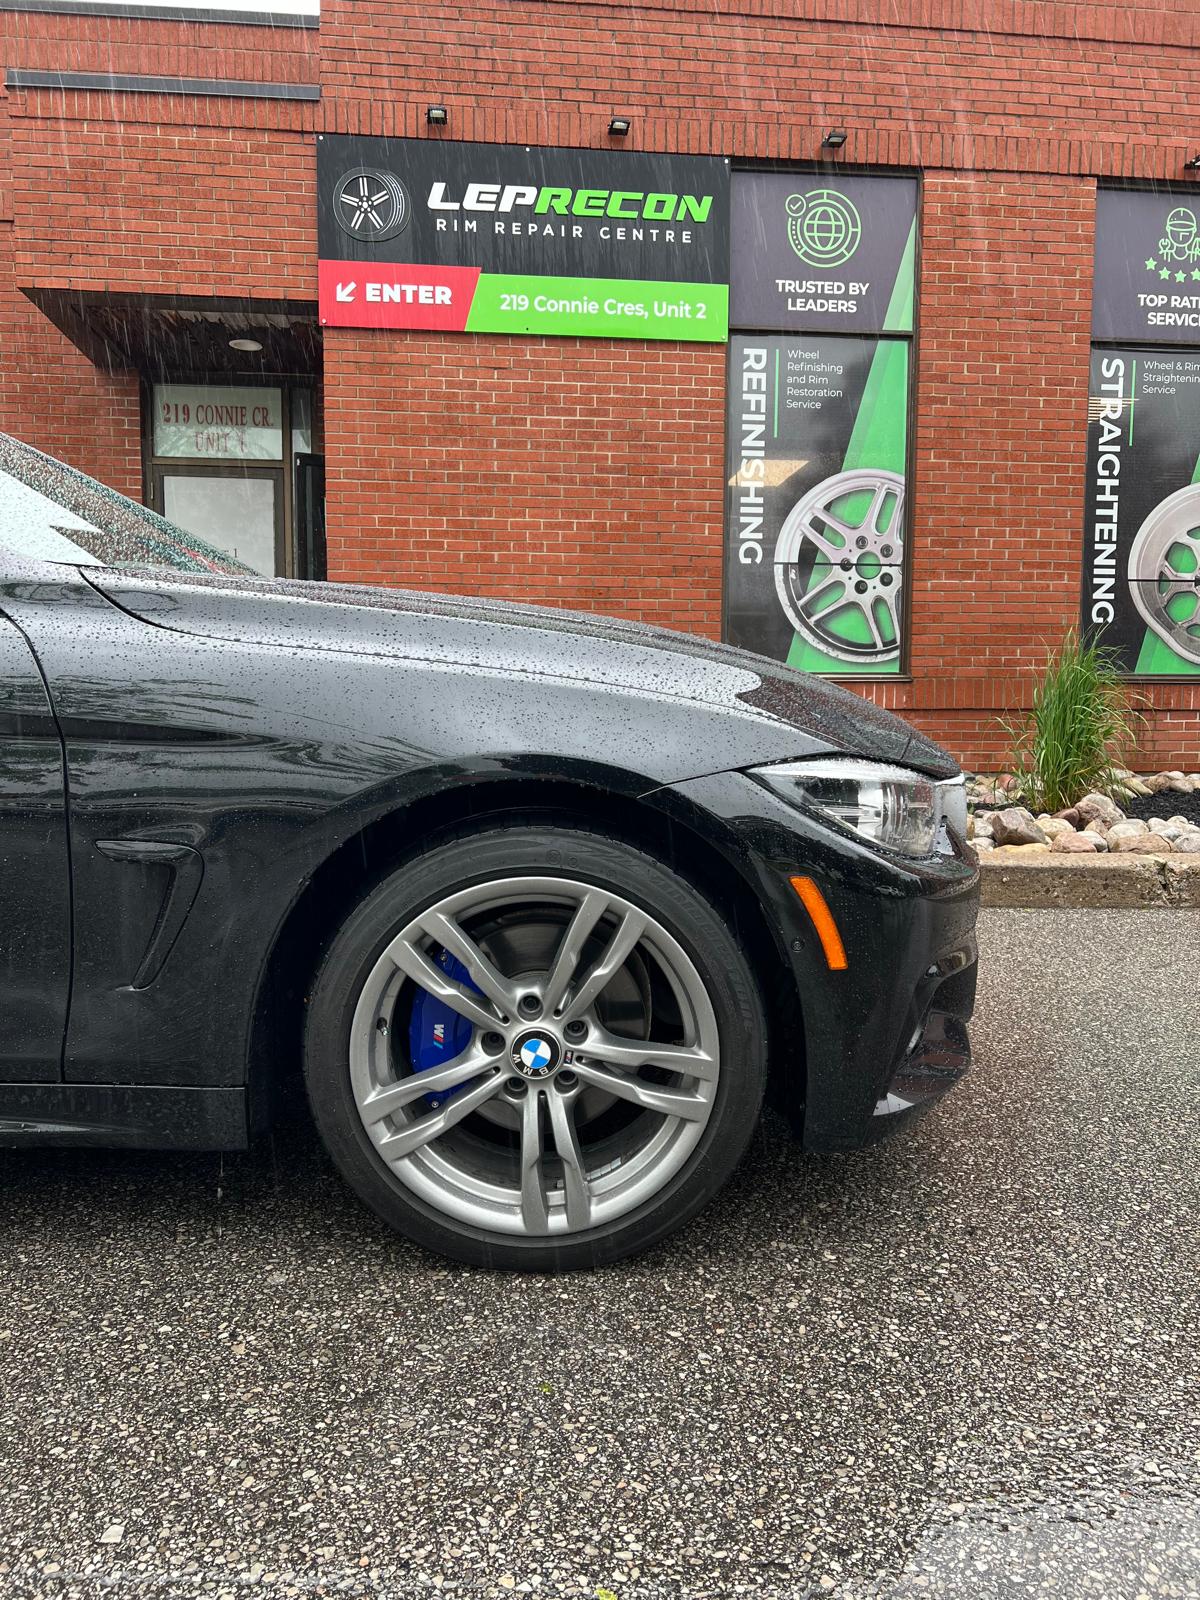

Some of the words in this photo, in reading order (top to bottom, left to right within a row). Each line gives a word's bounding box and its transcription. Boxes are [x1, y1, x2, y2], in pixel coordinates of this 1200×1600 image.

[427, 181, 713, 223] LEPRECON
[436, 218, 478, 233] RIM
[494, 221, 583, 239] REPAIR
[599, 227, 693, 244] CENTRE
[366, 282, 452, 306] ENTER
[775, 279, 846, 295] TRUSTED
[849, 282, 870, 295] BY
[500, 294, 529, 312] 219
[533, 295, 599, 315] Connie
[603, 299, 650, 319] Cres,
[654, 301, 692, 318] Unit
[695, 303, 707, 319] 2
[787, 298, 857, 313] LEADERS
[1137, 293, 1168, 308] TOP
[787, 350, 820, 360] Wheel
[787, 362, 843, 375] Refinishing
[1143, 361, 1174, 371] Wheel
[1176, 362, 1183, 371] &
[786, 375, 806, 385] and
[809, 376, 829, 385] Rim
[786, 387, 843, 398] Restoration
[1142, 385, 1176, 395] Service
[786, 400, 822, 409] Service
[163, 403, 190, 424] 219
[196, 405, 248, 426] CONNIE
[252, 407, 274, 427] CR.
[195, 432, 230, 452] UNIT
[738, 348, 768, 564] REFINISHING
[1091, 358, 1125, 625] STRAIGHTENING
[512, 1053, 549, 1076] BMW
